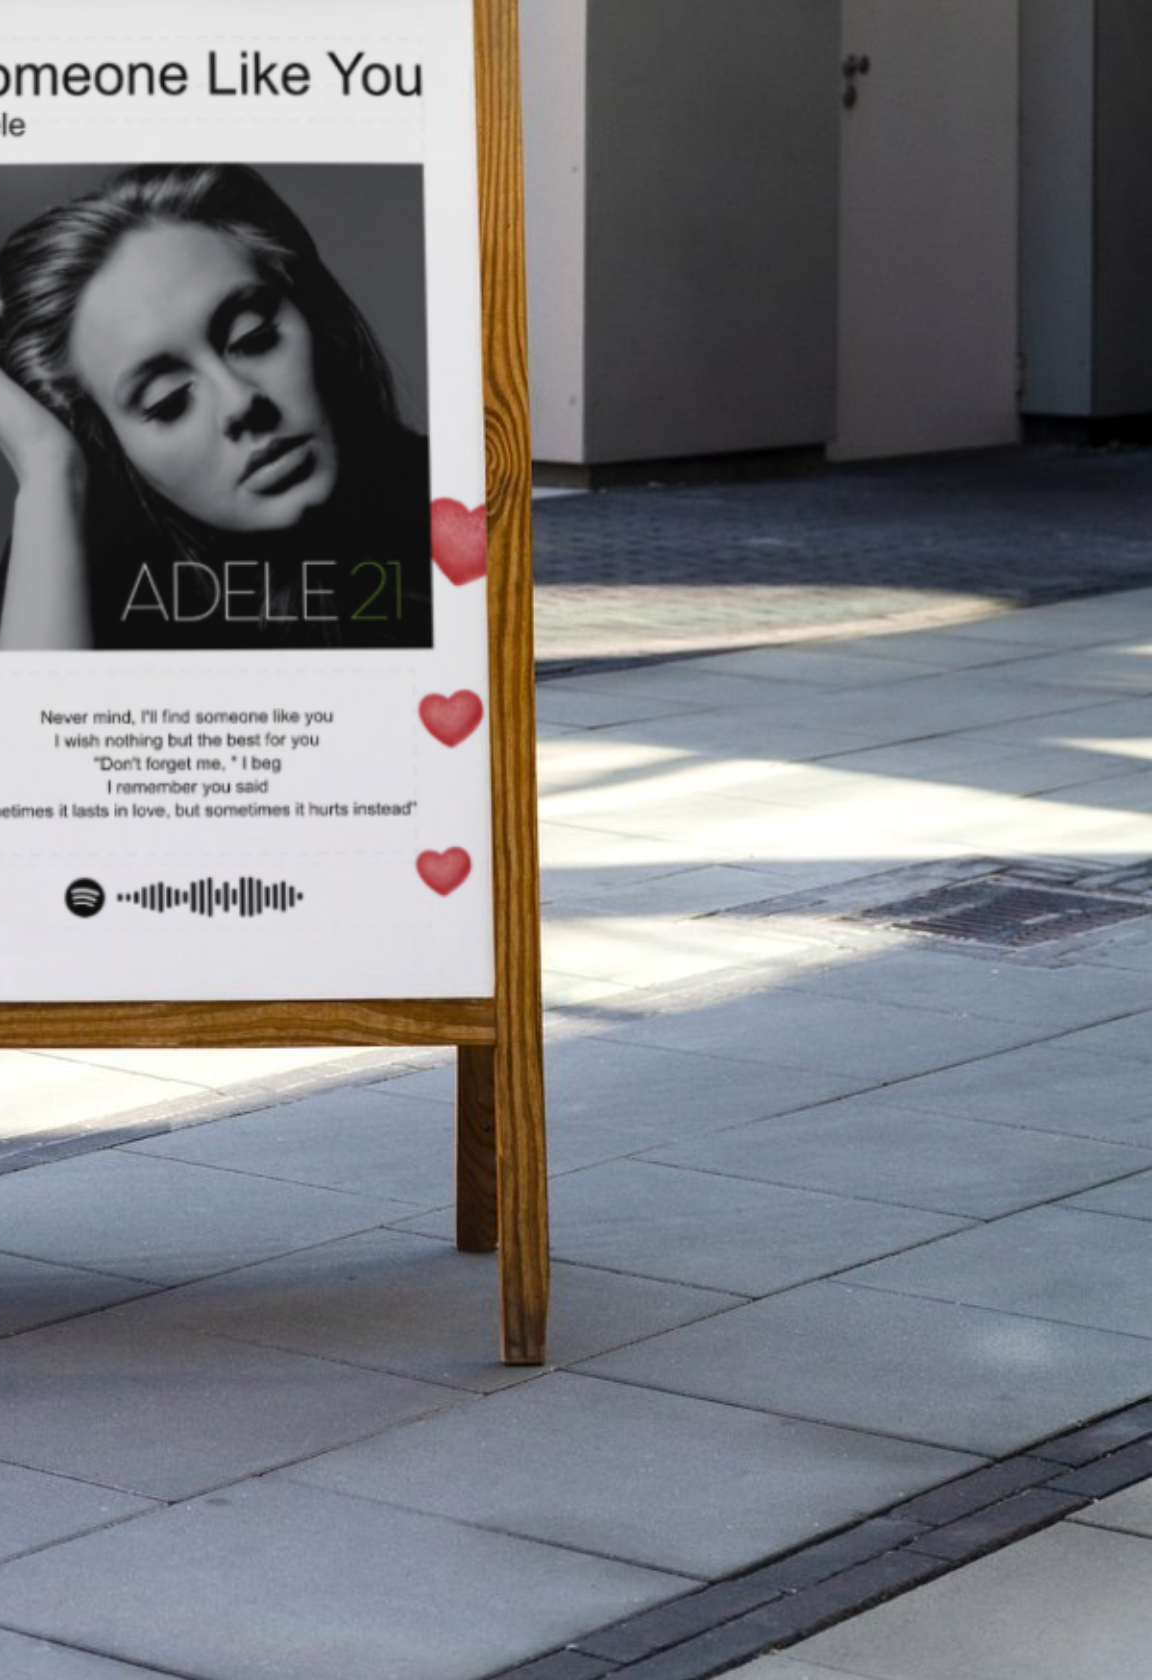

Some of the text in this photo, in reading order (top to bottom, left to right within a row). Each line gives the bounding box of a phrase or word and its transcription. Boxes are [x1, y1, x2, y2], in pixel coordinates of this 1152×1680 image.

[209, 51, 310, 96] Like
[327, 51, 423, 96] You
[121, 561, 403, 622] ADELE 21
[41, 709, 334, 727] Never mind, I'll find someone like you
[55, 732, 319, 751] I wish nothing but the best for you
[94, 756, 141, 771] "Don't
[146, 756, 192, 774] forget
[243, 756, 247, 770] I
[251, 756, 281, 773] beg
[107, 780, 268, 797] I remember you said
[59, 804, 68, 818] it
[72, 804, 109, 818] lasts
[114, 804, 128, 817] in
[132, 804, 170, 819] love,
[175, 803, 200, 817] but
[205, 803, 290, 817] sometimes
[295, 803, 304, 816] it
[309, 803, 349, 816] hurts
[353, 801, 417, 816] instead"
